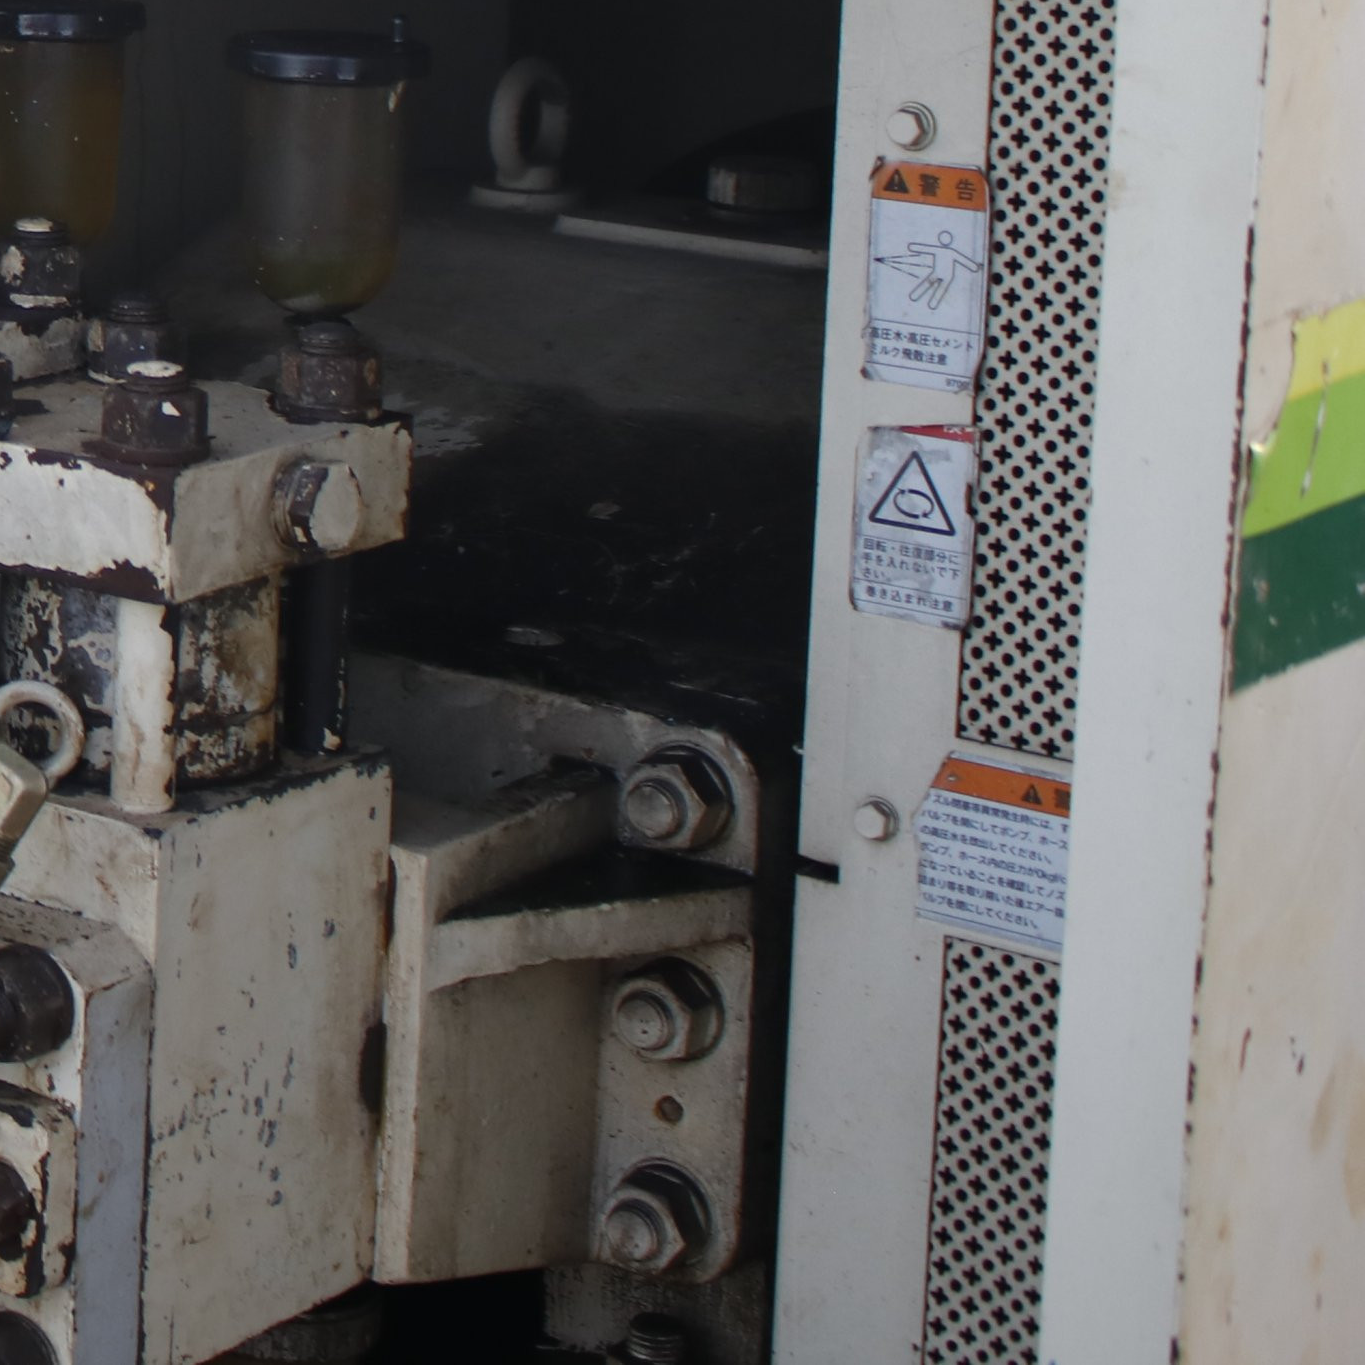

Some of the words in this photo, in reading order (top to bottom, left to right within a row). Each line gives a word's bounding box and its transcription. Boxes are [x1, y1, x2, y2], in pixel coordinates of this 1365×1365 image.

[862, 551, 962, 580] 手を入れないで下
